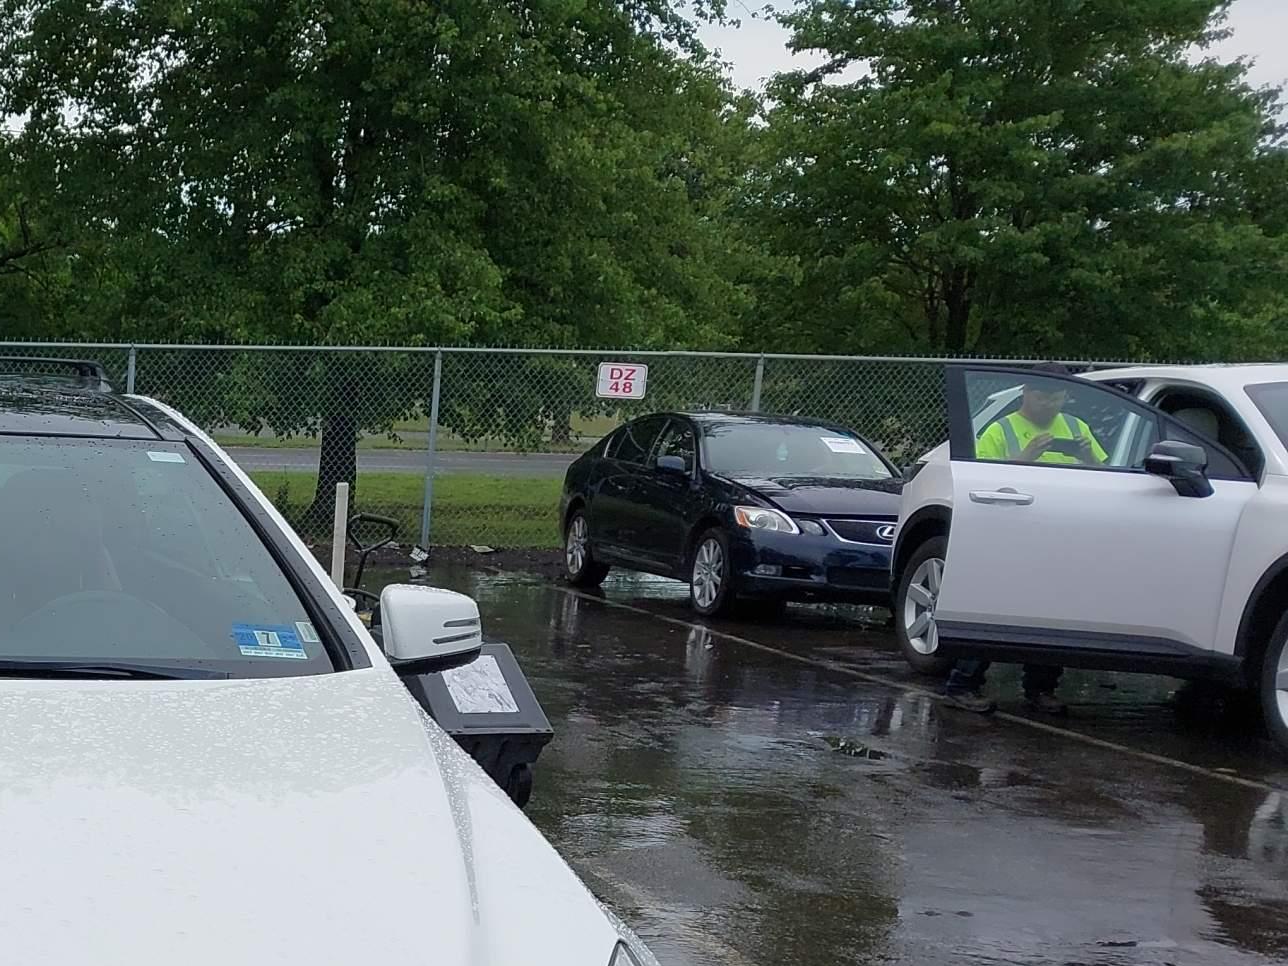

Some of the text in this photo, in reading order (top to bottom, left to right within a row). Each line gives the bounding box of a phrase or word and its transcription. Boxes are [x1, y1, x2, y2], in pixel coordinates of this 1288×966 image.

[610, 367, 637, 381] DZ
[609, 381, 633, 394] 48
[261, 632, 271, 644] 7
